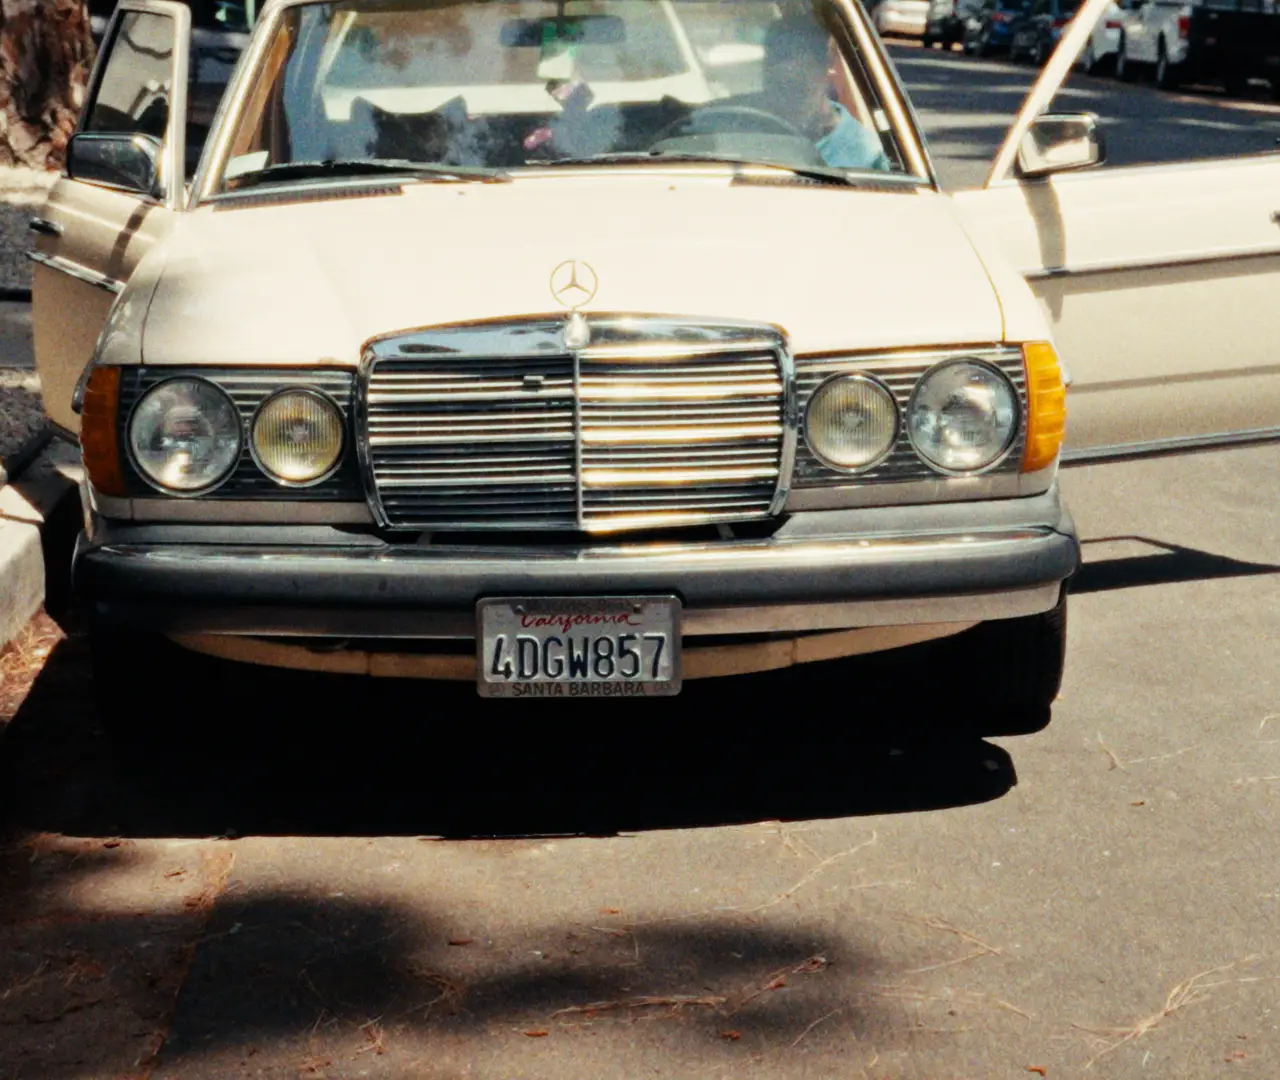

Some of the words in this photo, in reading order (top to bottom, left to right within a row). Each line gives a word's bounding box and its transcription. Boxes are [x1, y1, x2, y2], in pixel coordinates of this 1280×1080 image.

[491, 635, 666, 679] 4DGW857
[511, 683, 563, 697] SANTA
[570, 682, 645, 697] BARBARA
